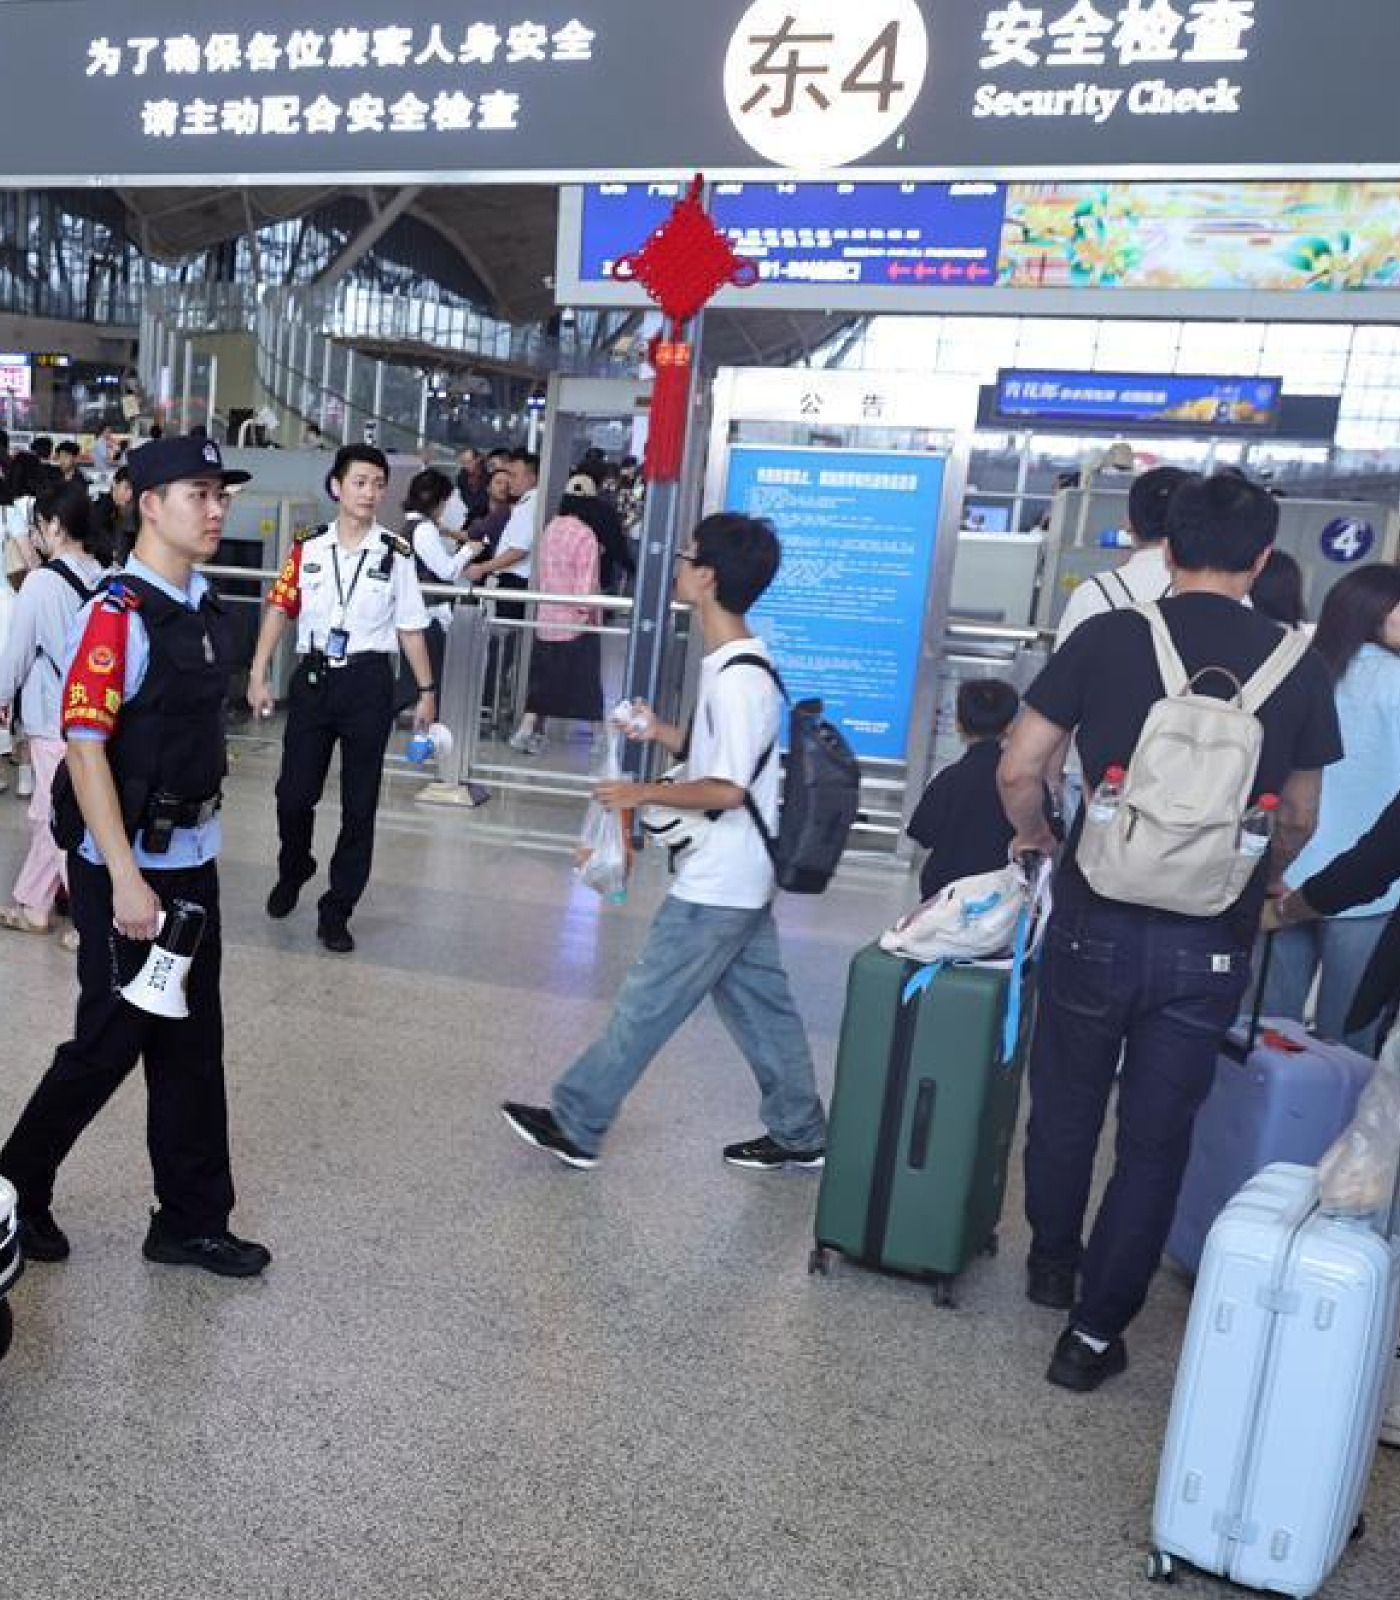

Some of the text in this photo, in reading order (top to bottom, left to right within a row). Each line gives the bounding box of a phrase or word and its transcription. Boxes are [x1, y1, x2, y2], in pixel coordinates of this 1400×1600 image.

[86, 19, 596, 76] 为了确保各位旅客人身安全
[978, 0, 1255, 69] 安全检查
[741, 16, 905, 118] 东4
[141, 90, 520, 137] 请主动配合安全检查
[972, 78, 1241, 122] Security Check
[1333, 521, 1361, 558] 4
